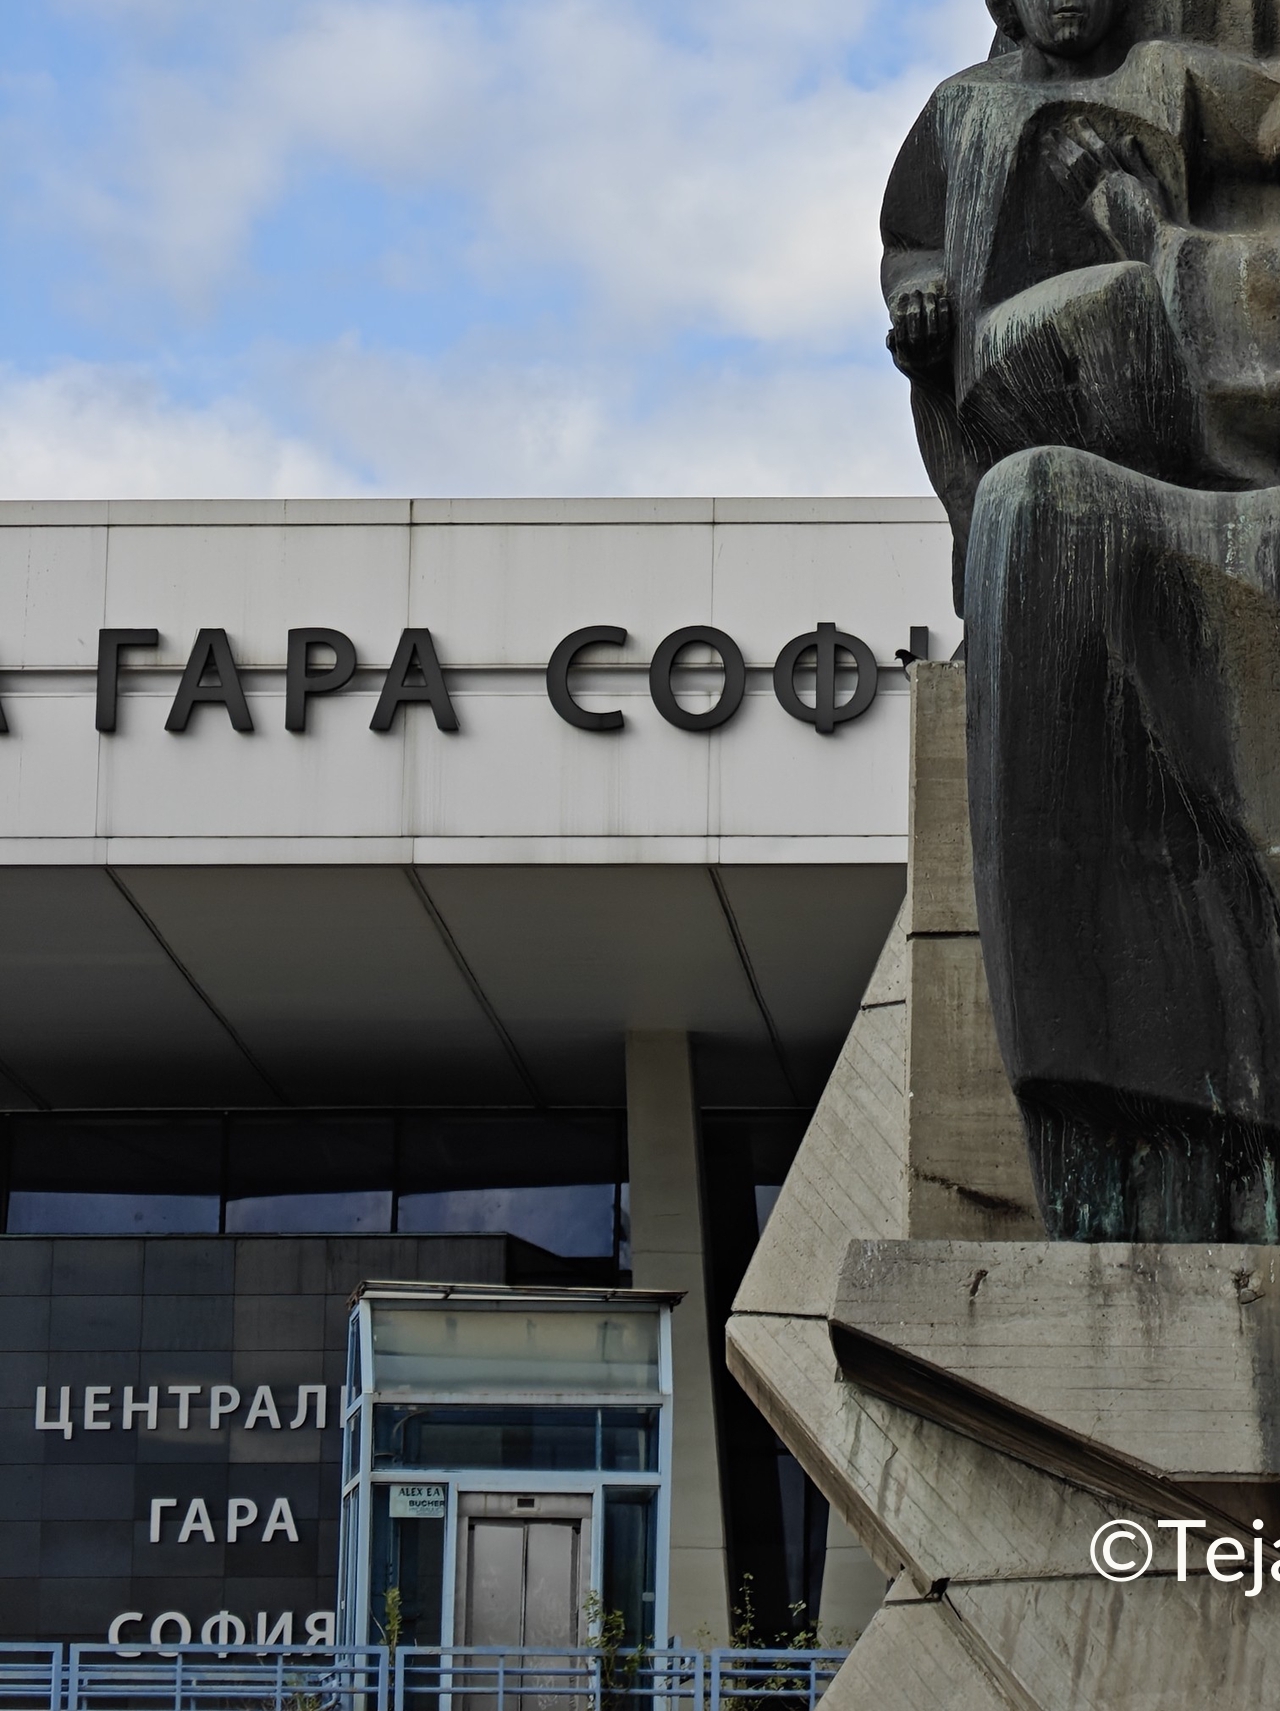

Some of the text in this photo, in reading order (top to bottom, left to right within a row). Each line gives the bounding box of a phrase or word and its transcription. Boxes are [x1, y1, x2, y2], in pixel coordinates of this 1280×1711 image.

[95, 622, 963, 733] ГАРА СОФ
[35, 1384, 355, 1440] ЦЕНТРАЛ
[398, 1487, 423, 1497] ALEX
[149, 1497, 299, 1543] ГАРА
[108, 1610, 335, 1658] СОФИЯ
